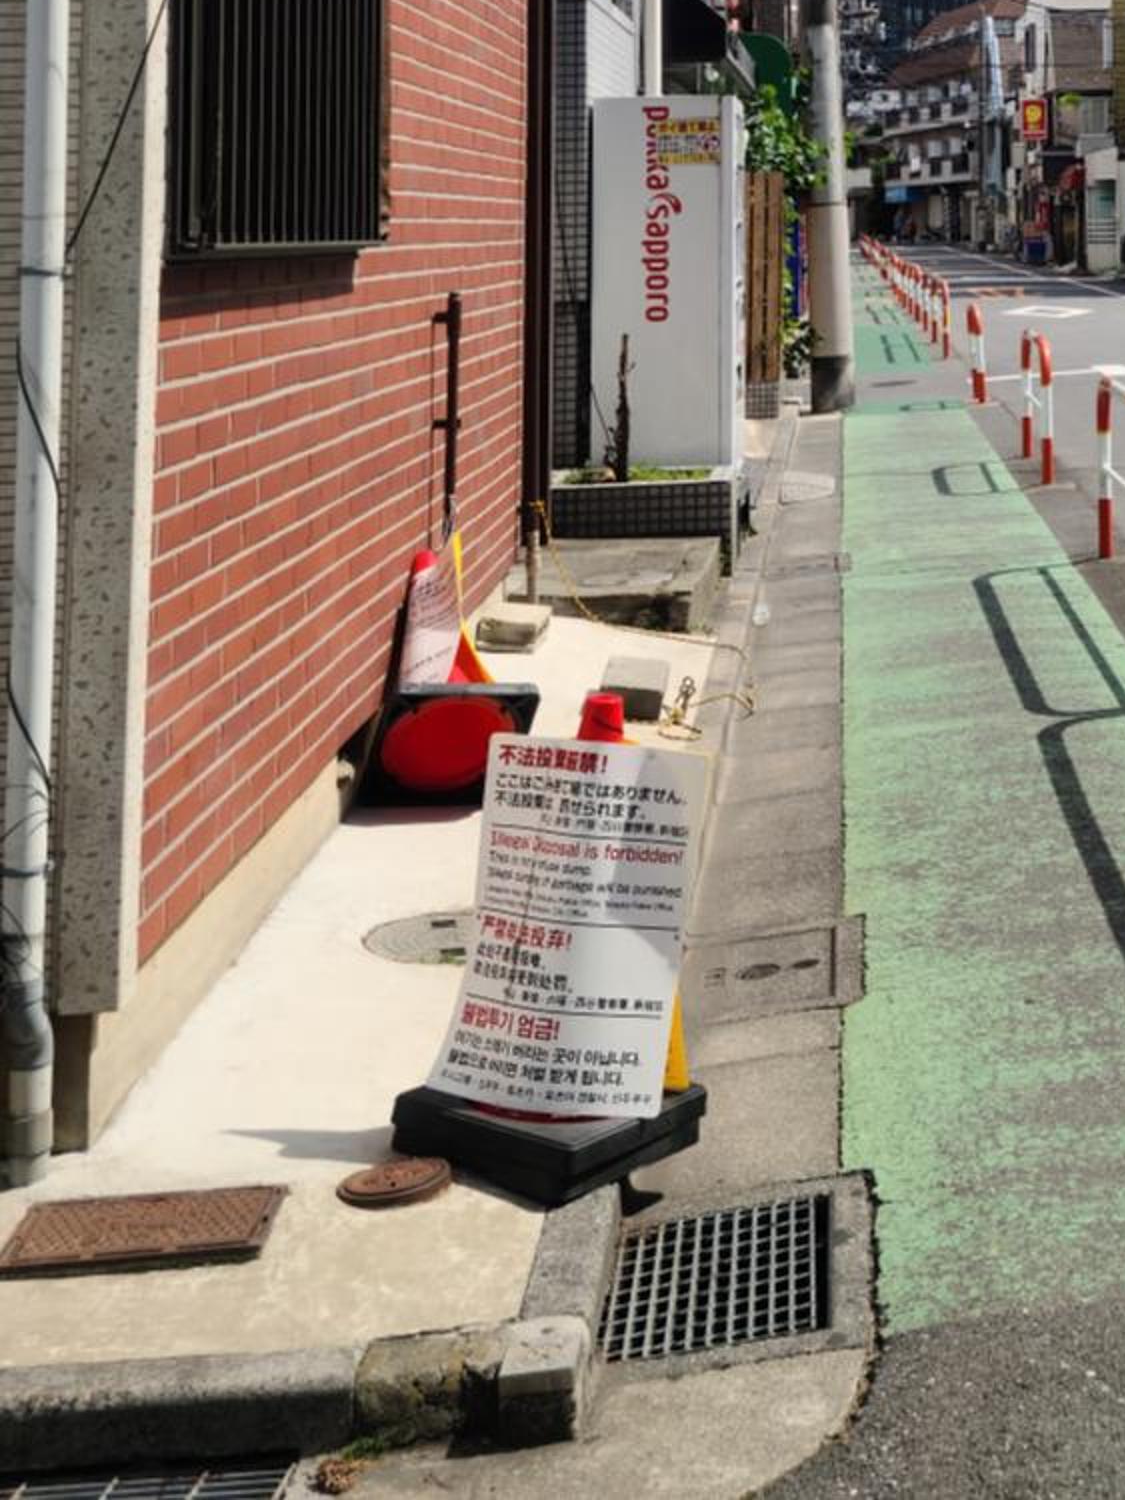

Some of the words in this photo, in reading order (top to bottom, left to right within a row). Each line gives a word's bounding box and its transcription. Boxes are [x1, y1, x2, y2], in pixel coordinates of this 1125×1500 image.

[642, 202, 669, 323] sapporo
[583, 843, 598, 860] is
[605, 843, 684, 864] forbidden!
[517, 1014, 560, 1041] 엄금!
